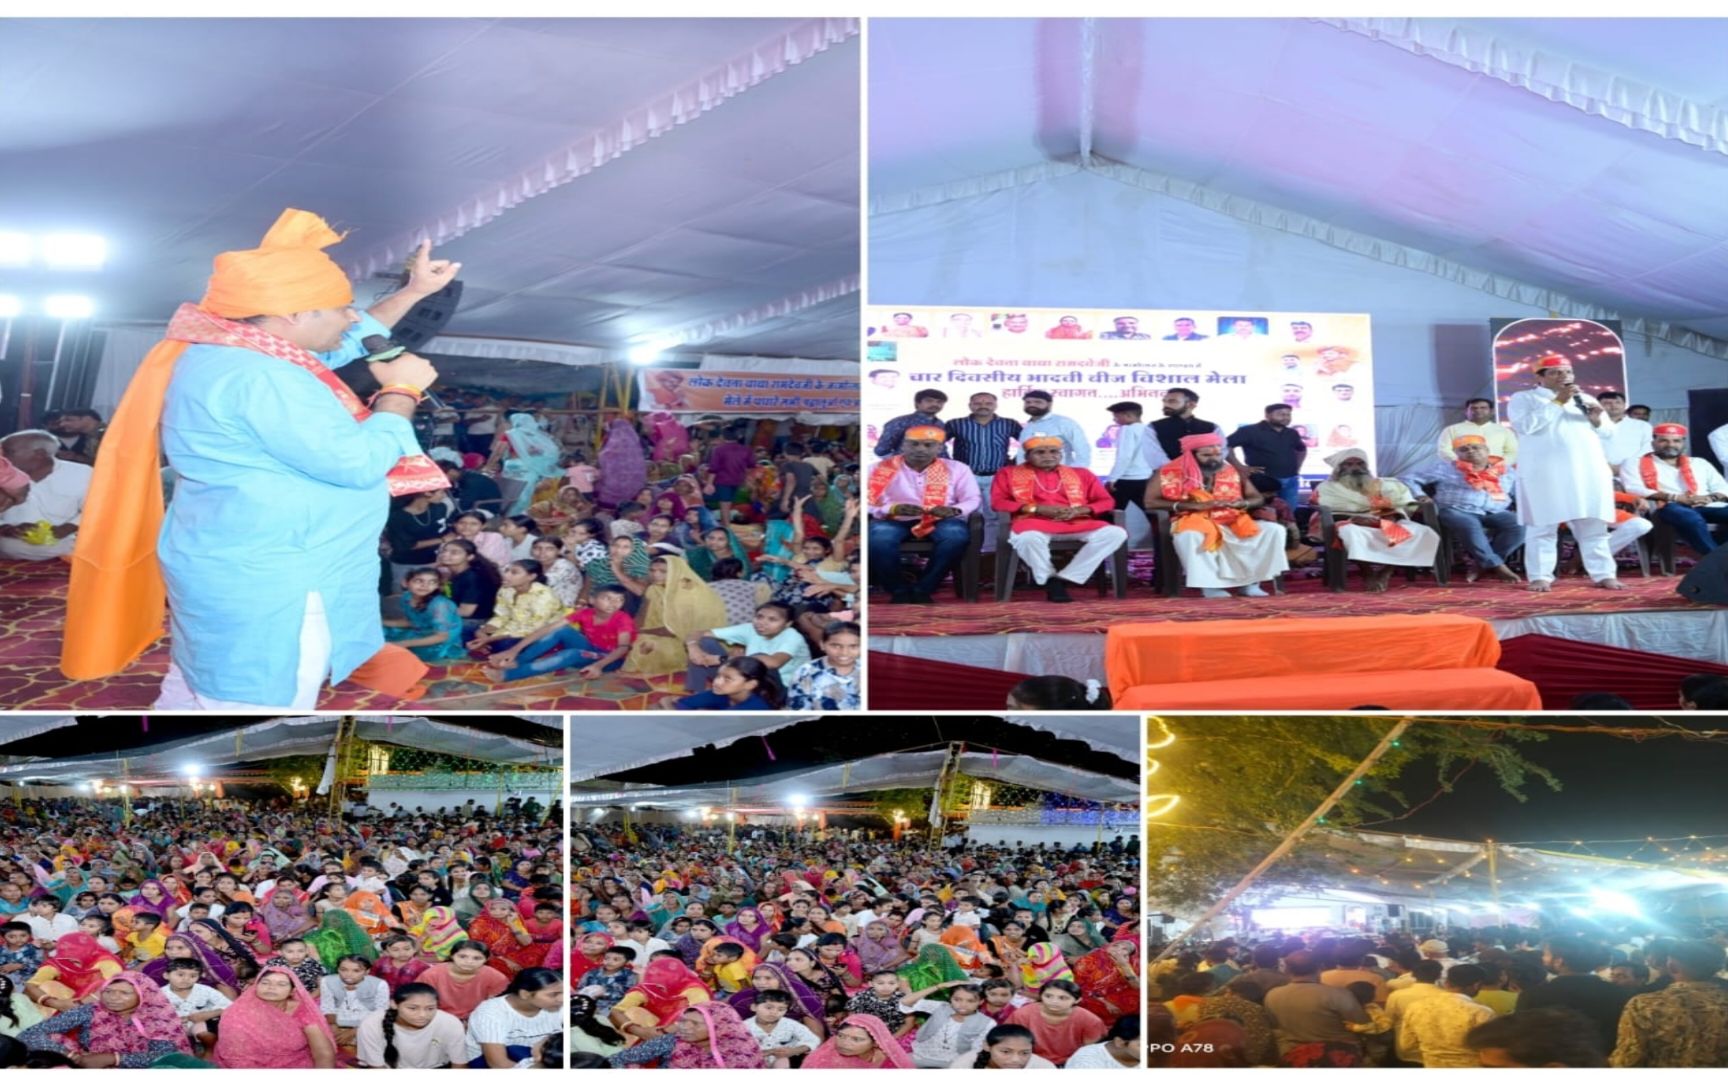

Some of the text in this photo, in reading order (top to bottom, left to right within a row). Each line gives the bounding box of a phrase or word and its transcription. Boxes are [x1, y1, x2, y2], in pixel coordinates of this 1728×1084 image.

[947, 370, 1021, 383] दिवसीय
[1027, 370, 1082, 383] भादवी
[1131, 370, 1200, 384] विशाल
[1205, 371, 1248, 384] मेला
